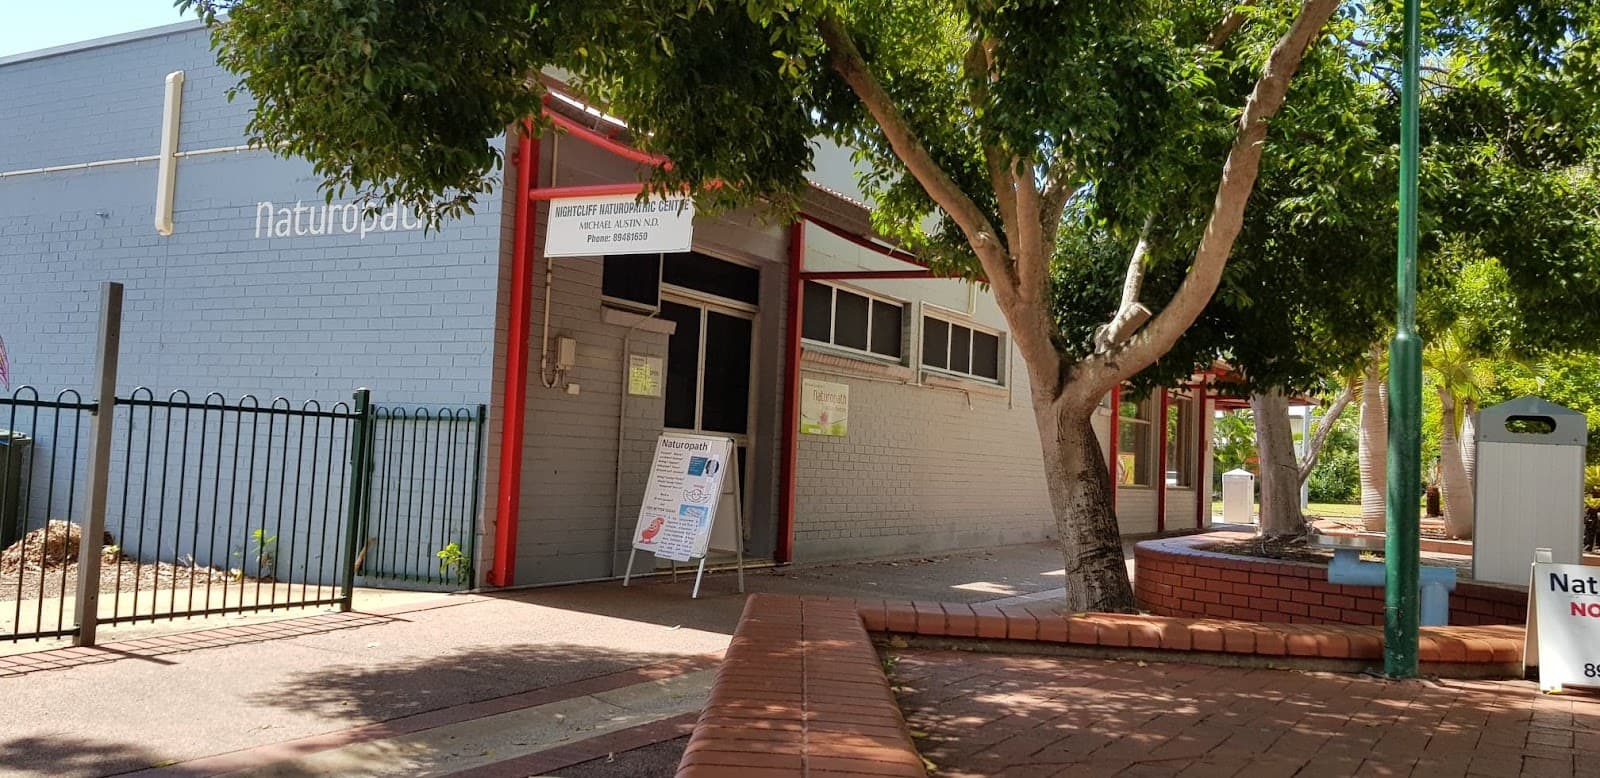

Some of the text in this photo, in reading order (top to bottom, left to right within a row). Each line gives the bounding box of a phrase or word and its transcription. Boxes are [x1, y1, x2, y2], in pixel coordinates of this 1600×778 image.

[555, 202, 597, 217] NIGHTCLIFF
[658, 199, 690, 212] CENTE
[579, 217, 659, 230] MICHAEL AUSTIN N.D.
[587, 232, 648, 243] Phone: 89481650
[661, 438, 708, 451] Naturopath
[1549, 572, 1598, 595] Nat
